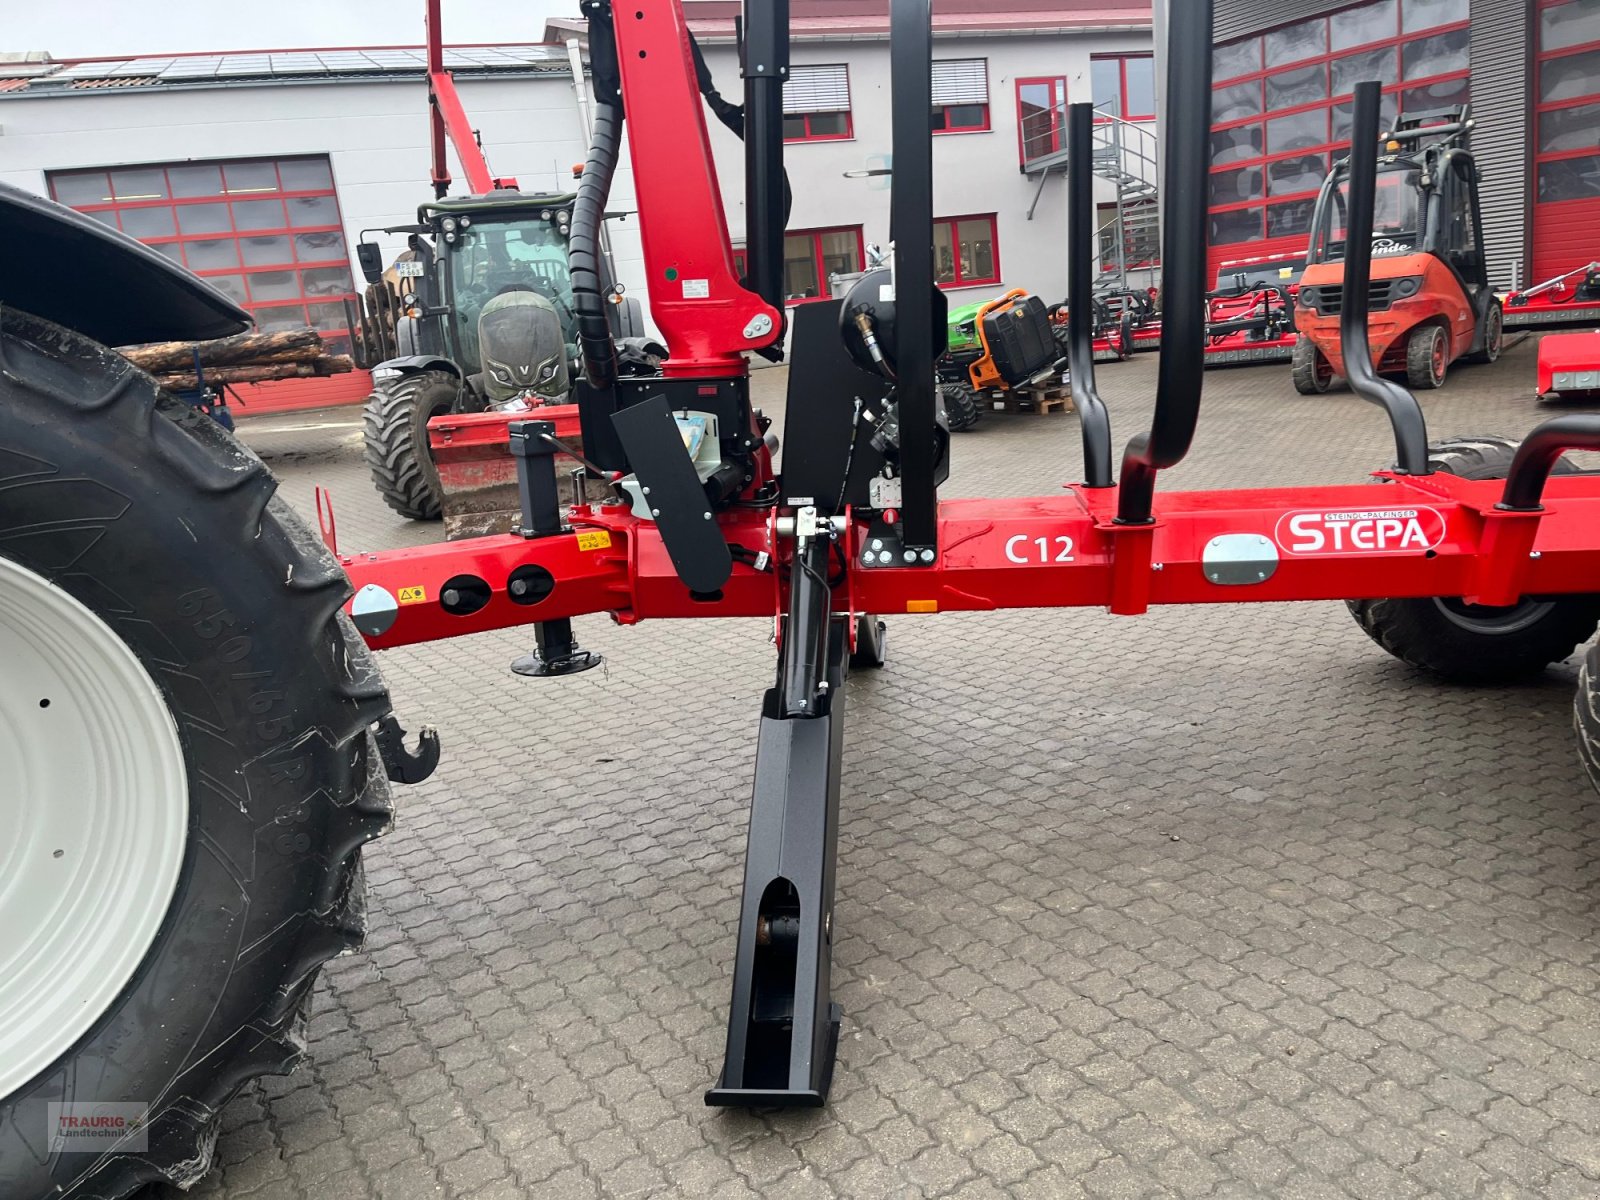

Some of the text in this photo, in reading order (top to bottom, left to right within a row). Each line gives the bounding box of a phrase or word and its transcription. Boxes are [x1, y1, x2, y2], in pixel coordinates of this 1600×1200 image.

[1005, 534, 1075, 563] C 12
[1289, 513, 1430, 551] STEPA
